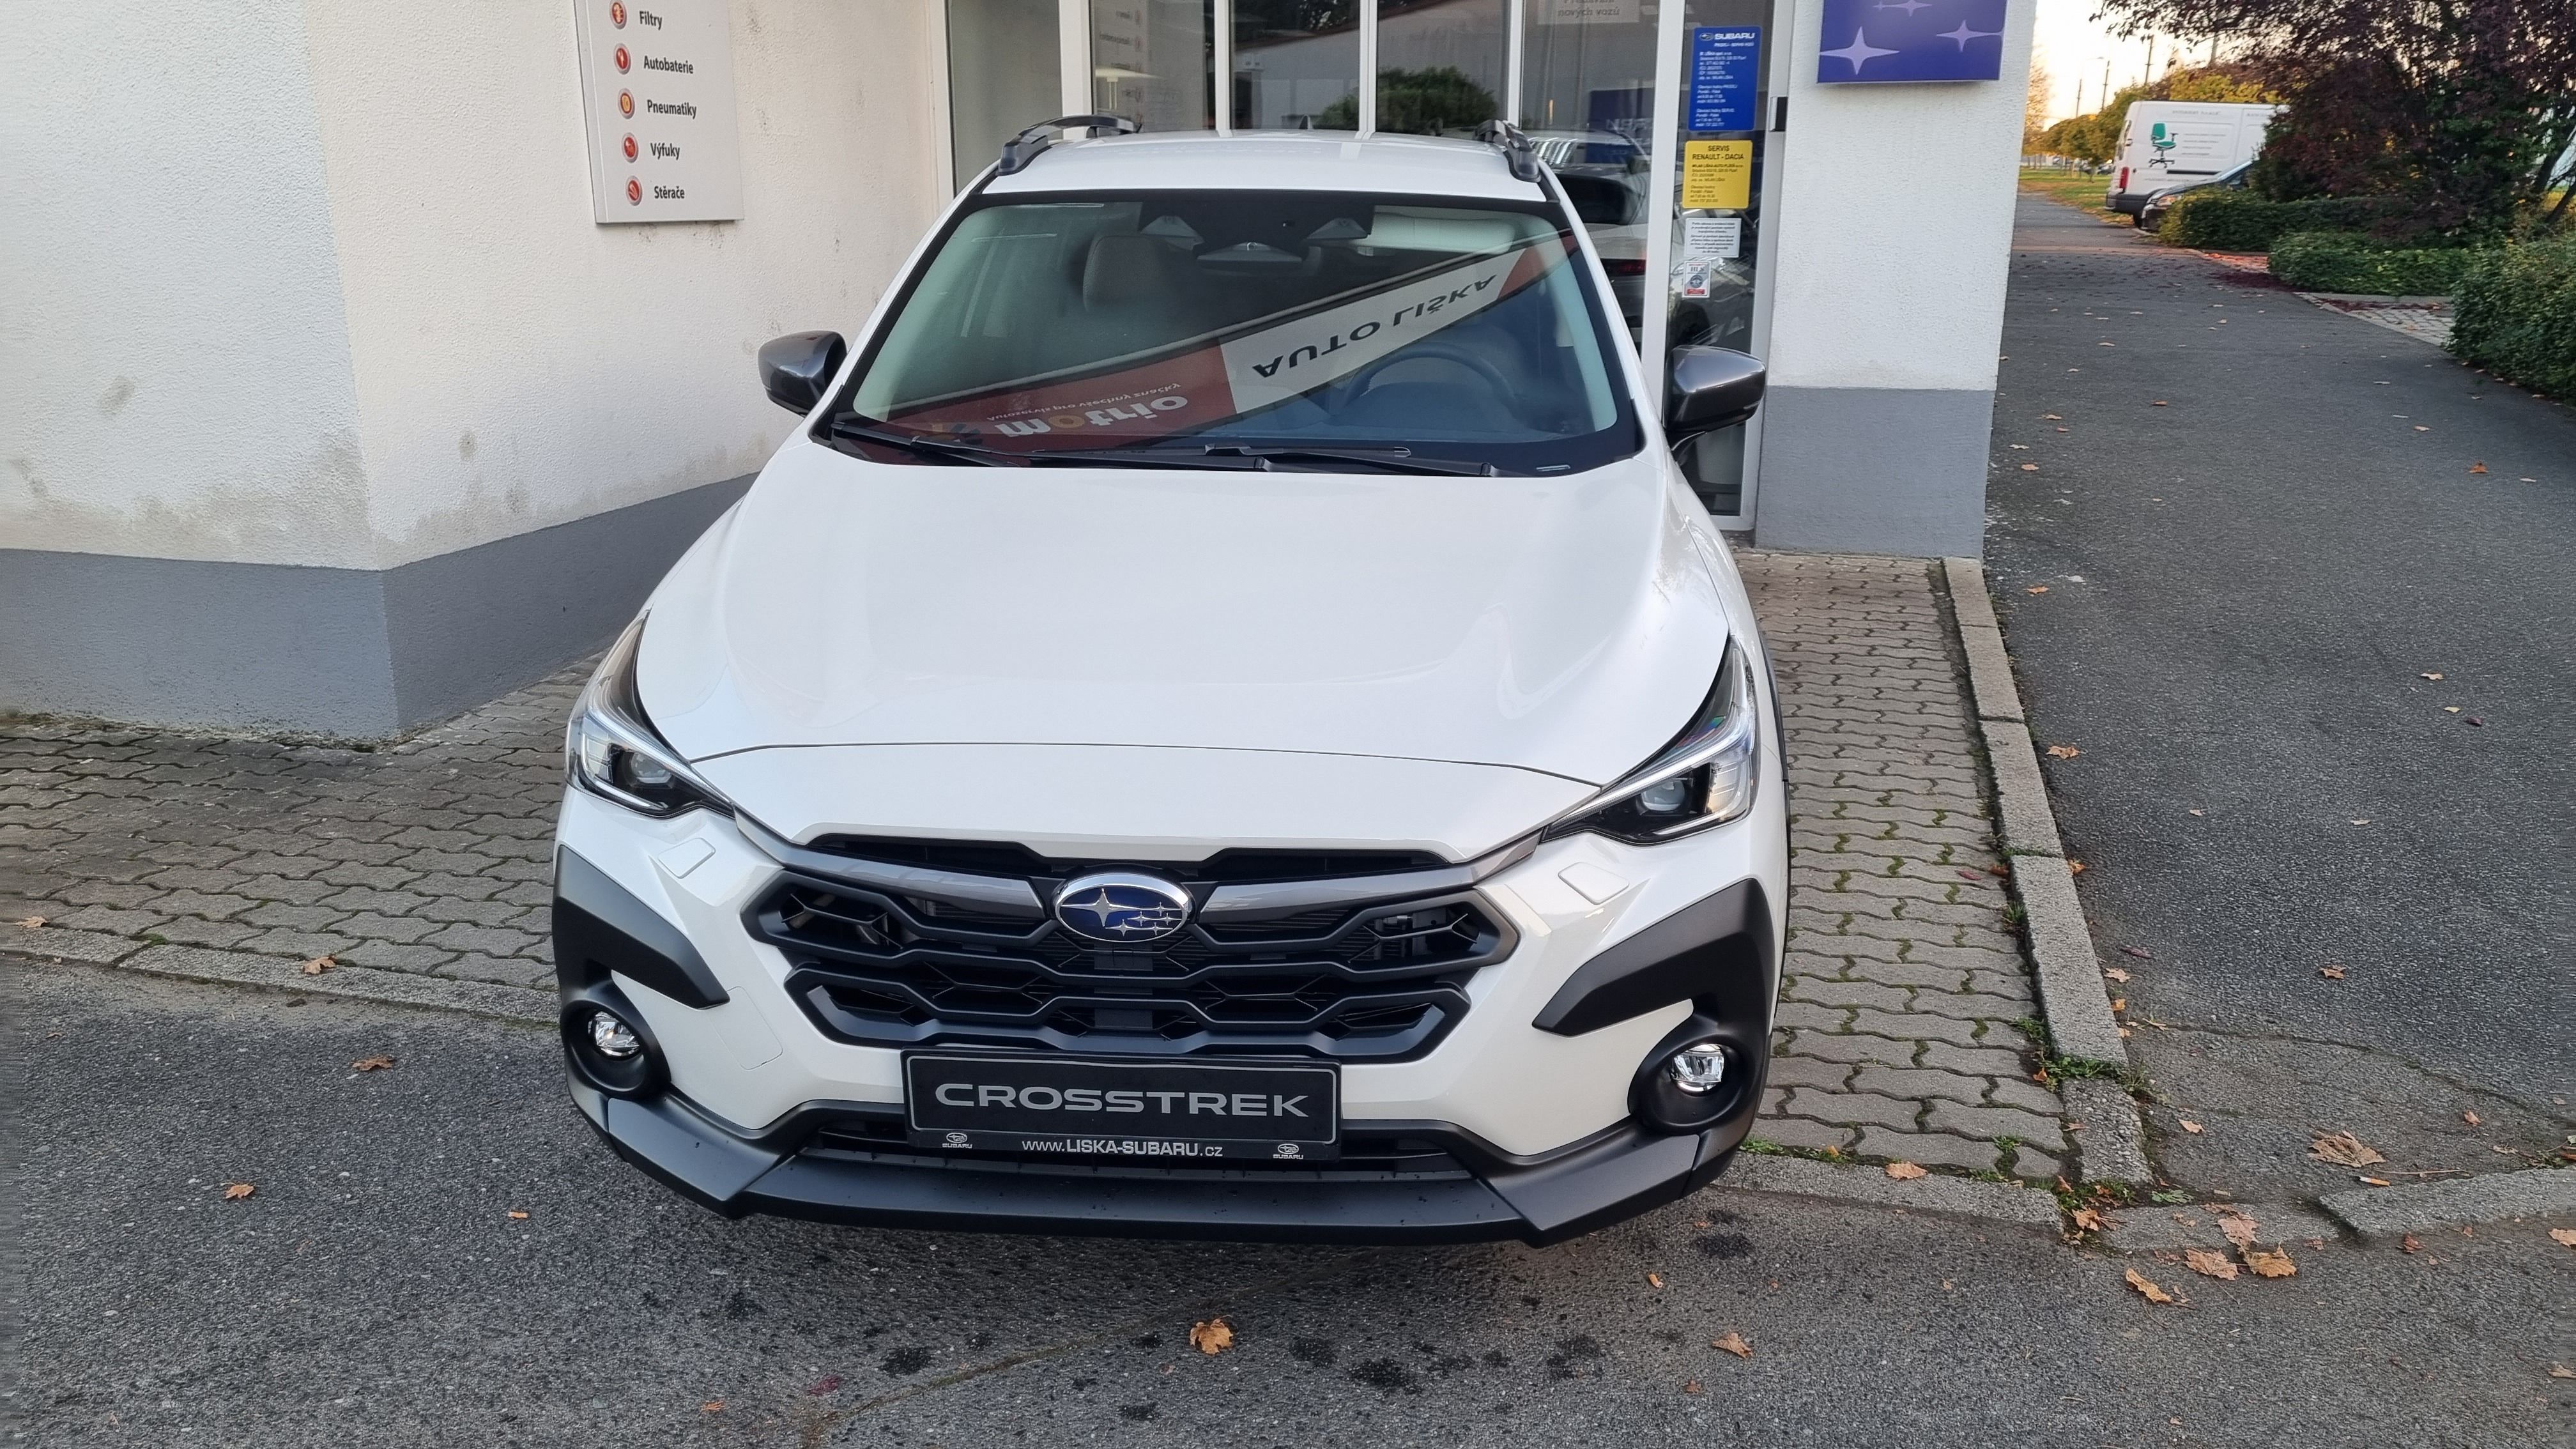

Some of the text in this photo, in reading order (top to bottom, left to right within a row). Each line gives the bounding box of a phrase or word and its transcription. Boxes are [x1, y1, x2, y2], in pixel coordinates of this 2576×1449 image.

[640, 11, 663, 30] Filtry
[644, 56, 694, 74] Autobaterie
[647, 100, 697, 119] Pneumatiky
[650, 142, 680, 160] Výfuky
[654, 186, 685, 199] Stěrače
[935, 1083, 1309, 1117] CROSSTREK
[1022, 1138, 1223, 1158] www.LISKA-SUBARU.cz
